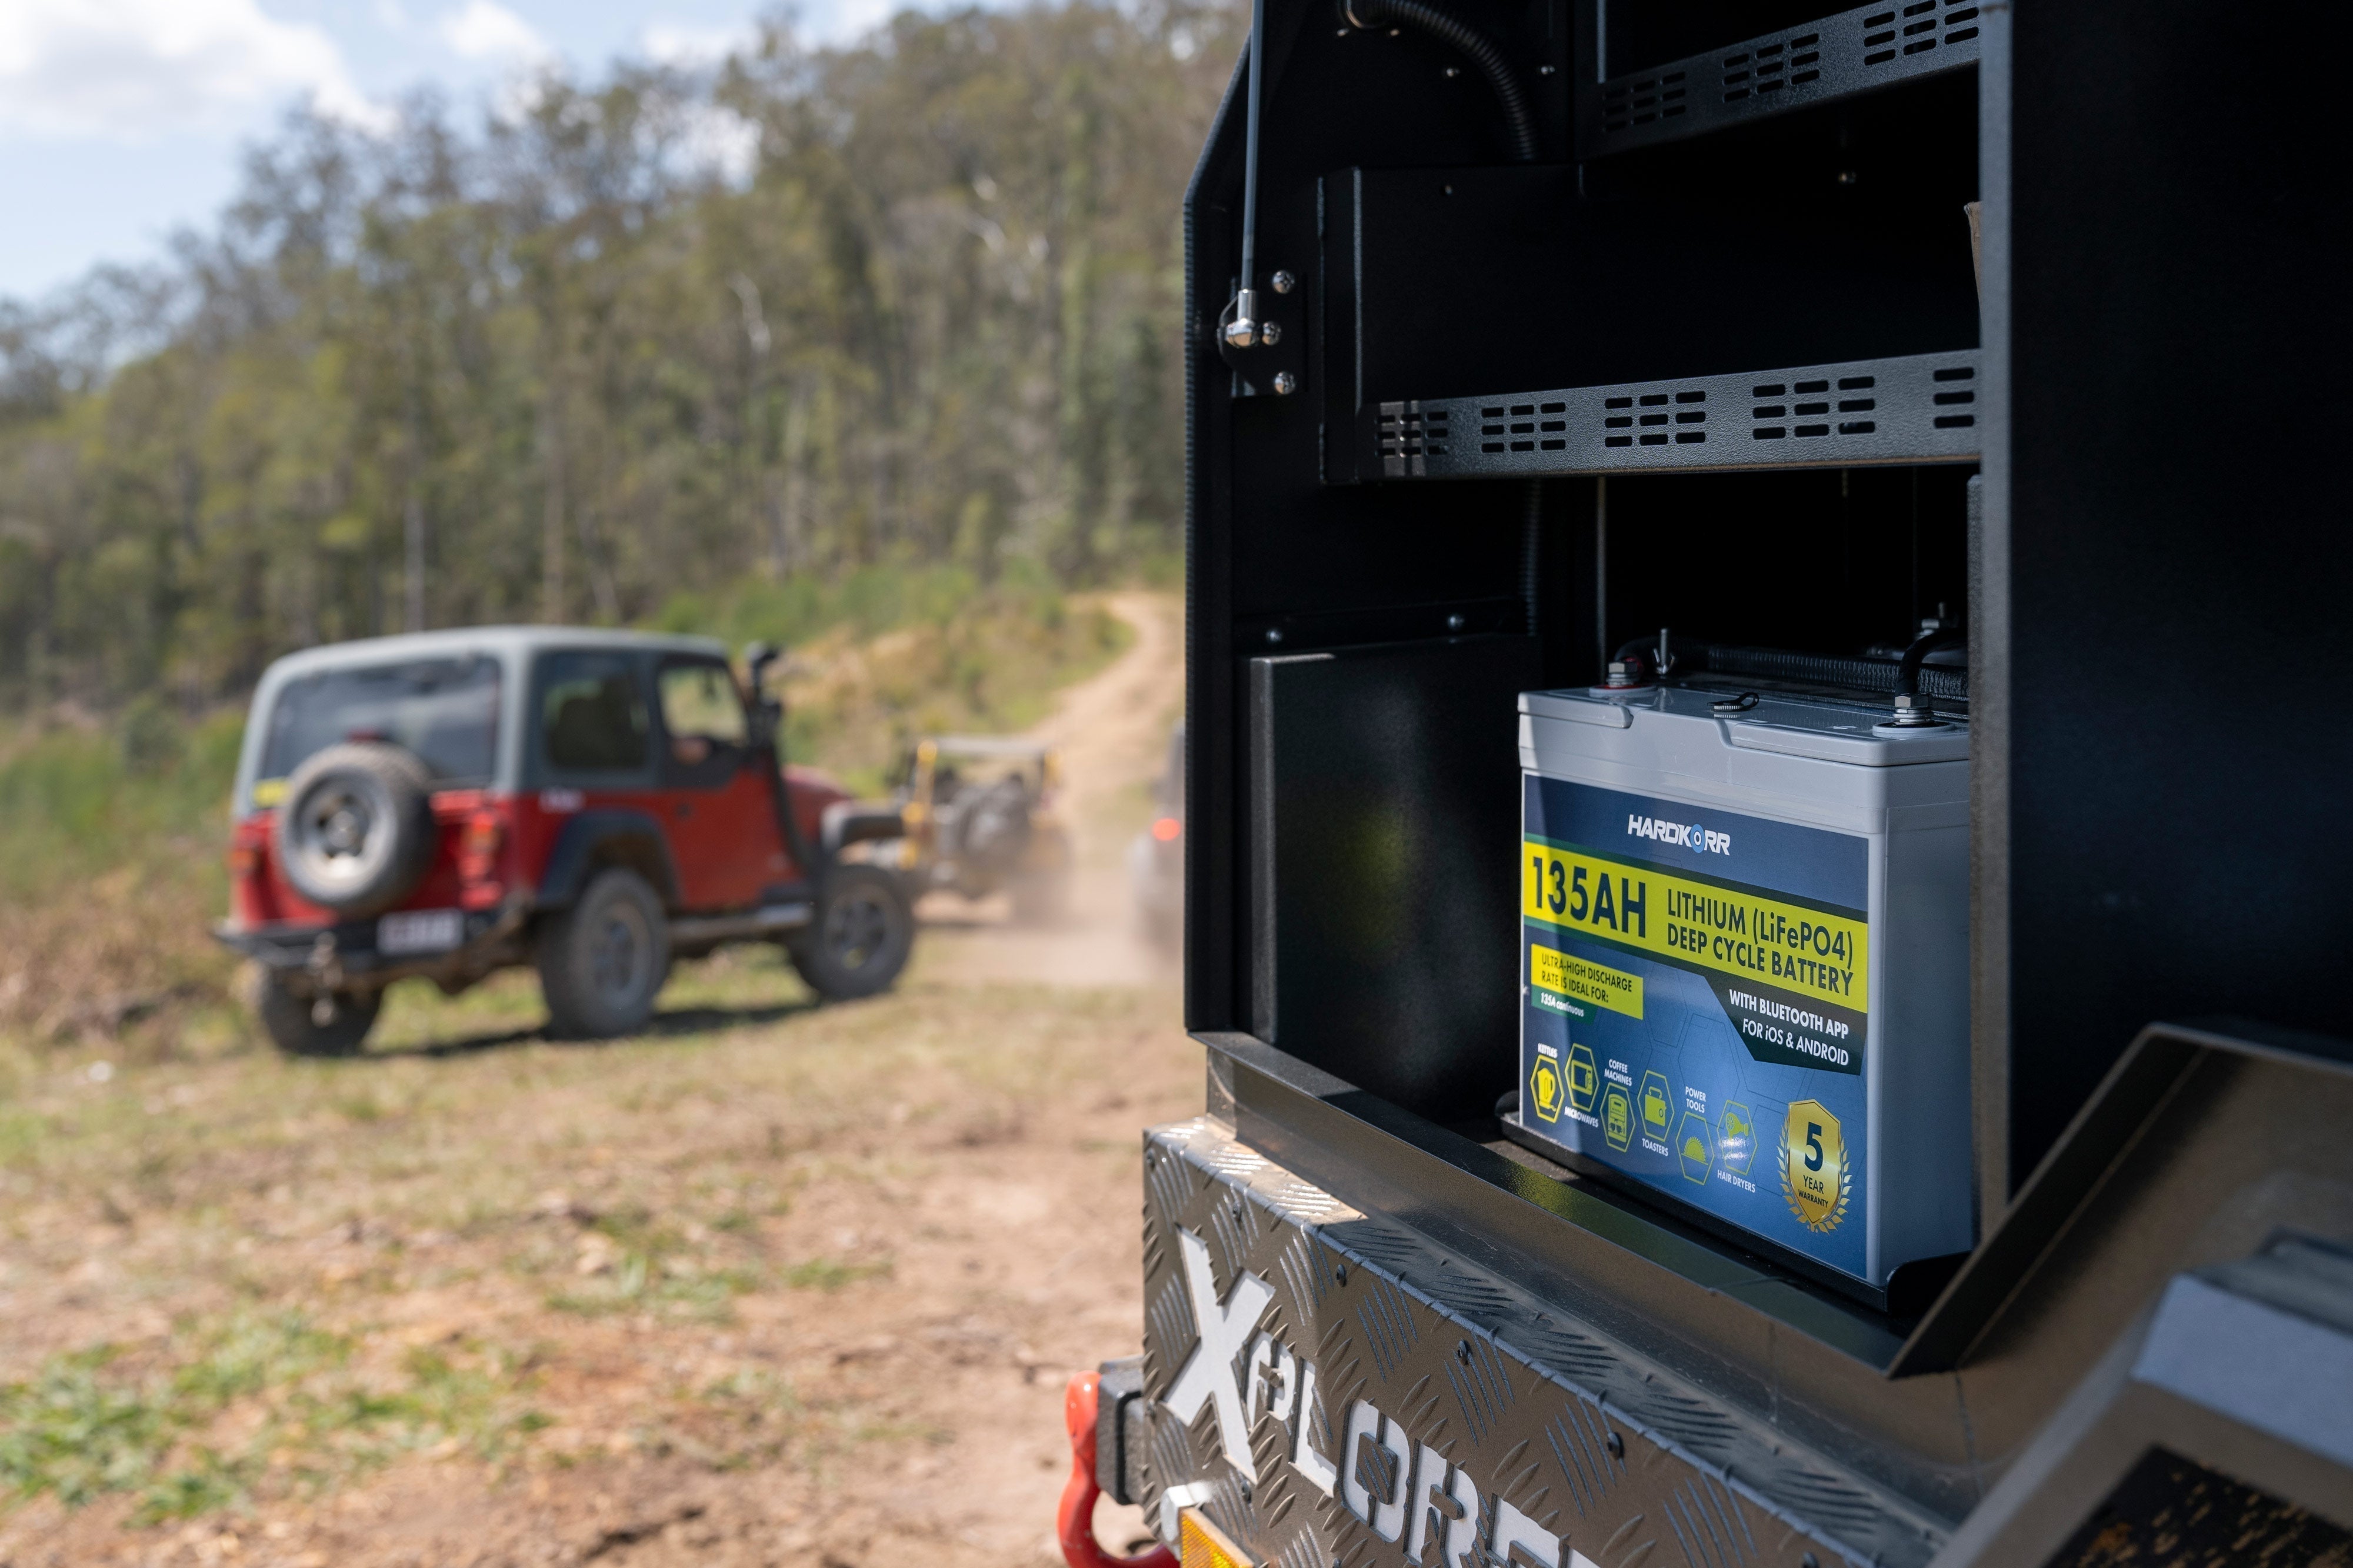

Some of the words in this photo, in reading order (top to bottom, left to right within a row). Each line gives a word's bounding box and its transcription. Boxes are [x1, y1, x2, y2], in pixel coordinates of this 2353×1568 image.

[1628, 815, 1730, 855] HARDKORR
[1532, 857, 1646, 938] 135AH
[1668, 889, 1745, 936] LITHIUM
[1753, 907, 1852, 970] (LiFePO4)
[1668, 923, 1708, 953] DEEP
[1713, 936, 1764, 972] CYCLE
[1771, 950, 1854, 996] BATTERY
[1542, 953, 1585, 976] ULTRA-HIGH
[1588, 968, 1632, 992] DISCHARGE
[1542, 970, 1558, 986] RATE
[1561, 976, 1567, 989] IS
[1569, 978, 1589, 996] IDEAL
[1591, 986, 1608, 1002] FOR:
[1541, 992, 1556, 1008] 135A
[1556, 1000, 1584, 1017] continuous
[1729, 989, 1757, 1010] WITH
[1759, 999, 1822, 1030] BLUETOOTH
[1825, 1019, 1848, 1039] APP
[1538, 1043, 1558, 1058] KETTLES
[1742, 1018, 1762, 1039] FOR
[1765, 1025, 1783, 1045] iOS
[1786, 1032, 1794, 1048] &
[1796, 1036, 1848, 1065] ANDROID
[1604, 1068, 1632, 1086] MACHINES
[1608, 1059, 1628, 1073] COFFEE
[1685, 1086, 1706, 1102] POWER
[1687, 1098, 1705, 1113] TOOLS
[1564, 1106, 1599, 1127] MICROWAVES
[1642, 1137, 1668, 1156] TOASTERS
[1804, 1122, 1824, 1172] 5
[1717, 1169, 1732, 1184] HAIR
[1733, 1176, 1755, 1193] DRYERS
[1803, 1175, 1824, 1194] YEAR
[1798, 1189, 1828, 1208] WARRANTY
